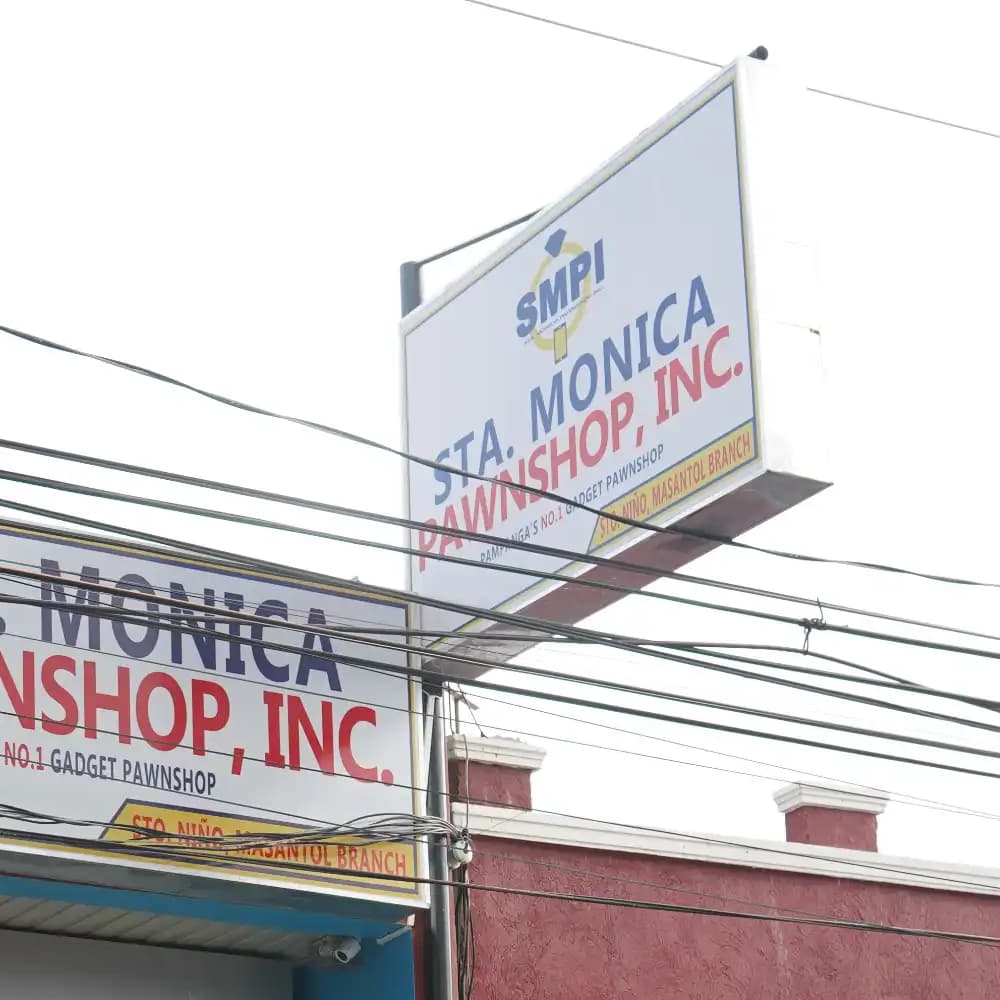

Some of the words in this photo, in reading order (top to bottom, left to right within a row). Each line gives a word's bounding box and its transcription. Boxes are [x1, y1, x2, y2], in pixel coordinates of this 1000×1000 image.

[517, 238, 604, 337] SMPI
[433, 418, 514, 505] STA.
[530, 275, 715, 442] MONICA
[418, 391, 644, 572] PAWNSHOP,
[653, 325, 743, 425] INC.
[540, 507, 563, 530] NO.1
[606, 444, 664, 492] PAWNSHOP
[651, 460, 706, 506] MASANTOL
[708, 431, 751, 475] BRANCH
[40, 558, 342, 692] MONICA
[4, 741, 45, 771] NO.1
[50, 748, 117, 781] GADGET
[122, 759, 217, 796] PAWNSHOP
[263, 690, 394, 786] INC.
[337, 843, 407, 876] BRANCH
